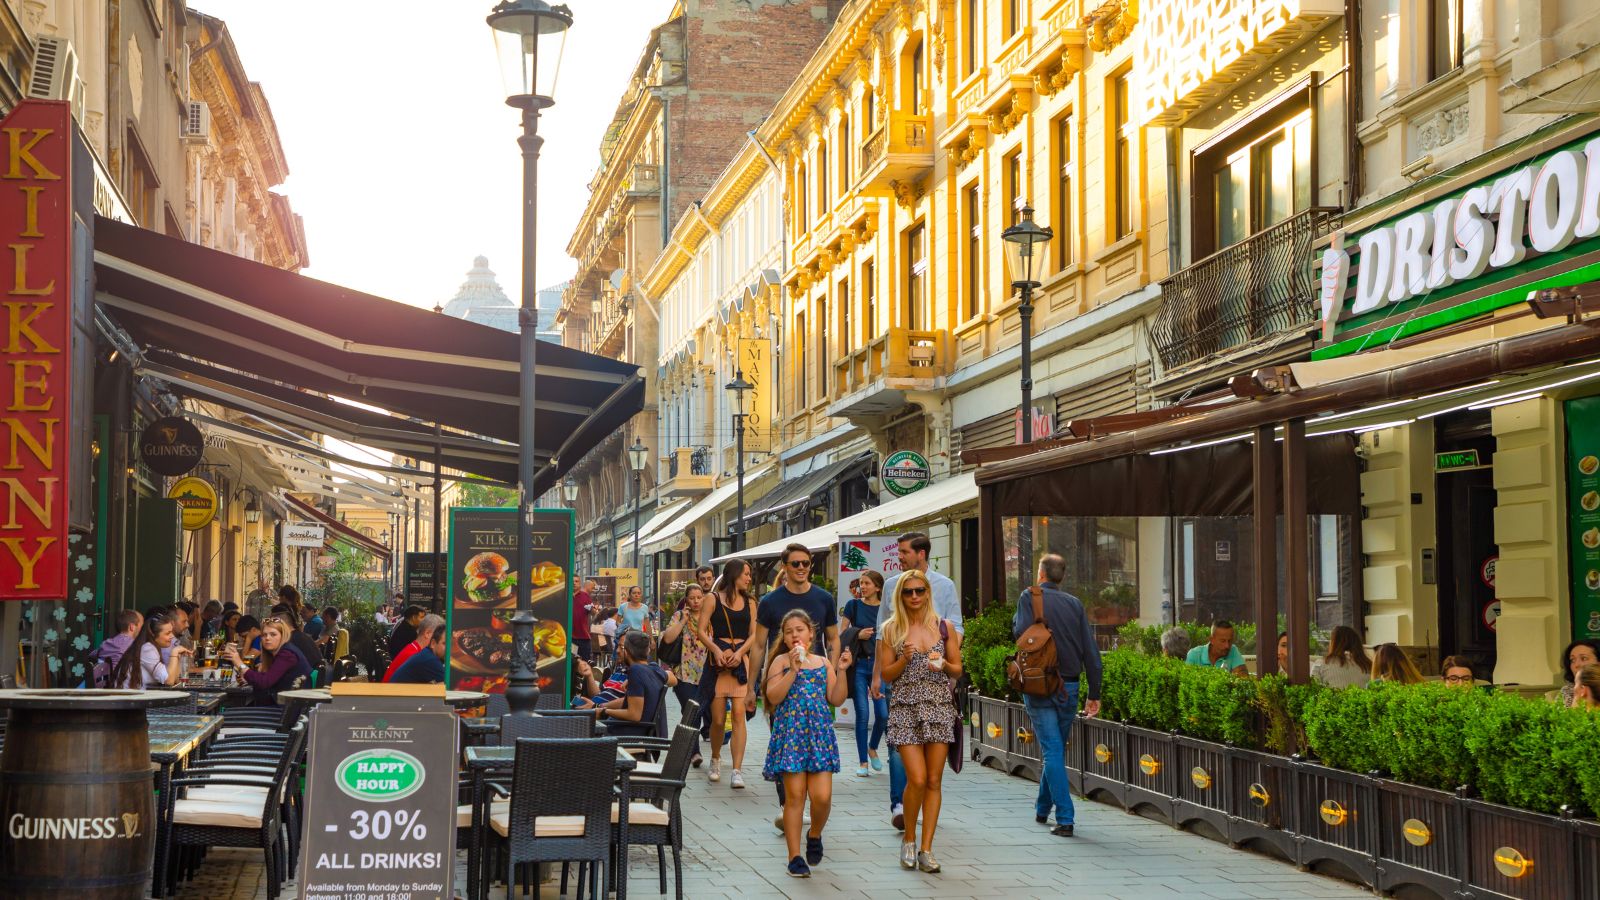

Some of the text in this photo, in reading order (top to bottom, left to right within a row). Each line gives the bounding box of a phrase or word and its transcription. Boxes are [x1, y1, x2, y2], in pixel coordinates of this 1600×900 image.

[1, 128, 61, 590] KILKENNY
[748, 349, 761, 438] MANSION
[144, 443, 198, 457] GUINNESS
[1451, 454, 1465, 466] WC
[888, 469, 925, 478] Heineken
[475, 534, 547, 546] KILKENY
[882, 542, 899, 552] LEBAN
[882, 558, 902, 572] Fin
[352, 730, 410, 739] KILKENNY
[357, 762, 407, 773] HAPPY
[356, 779, 399, 790] HOUR
[9, 813, 116, 839] GUINNESS
[349, 809, 427, 840] 30%
[316, 852, 442, 869] ALL DRINKS!
[306, 882, 443, 893] Available from Monday to Sunday
